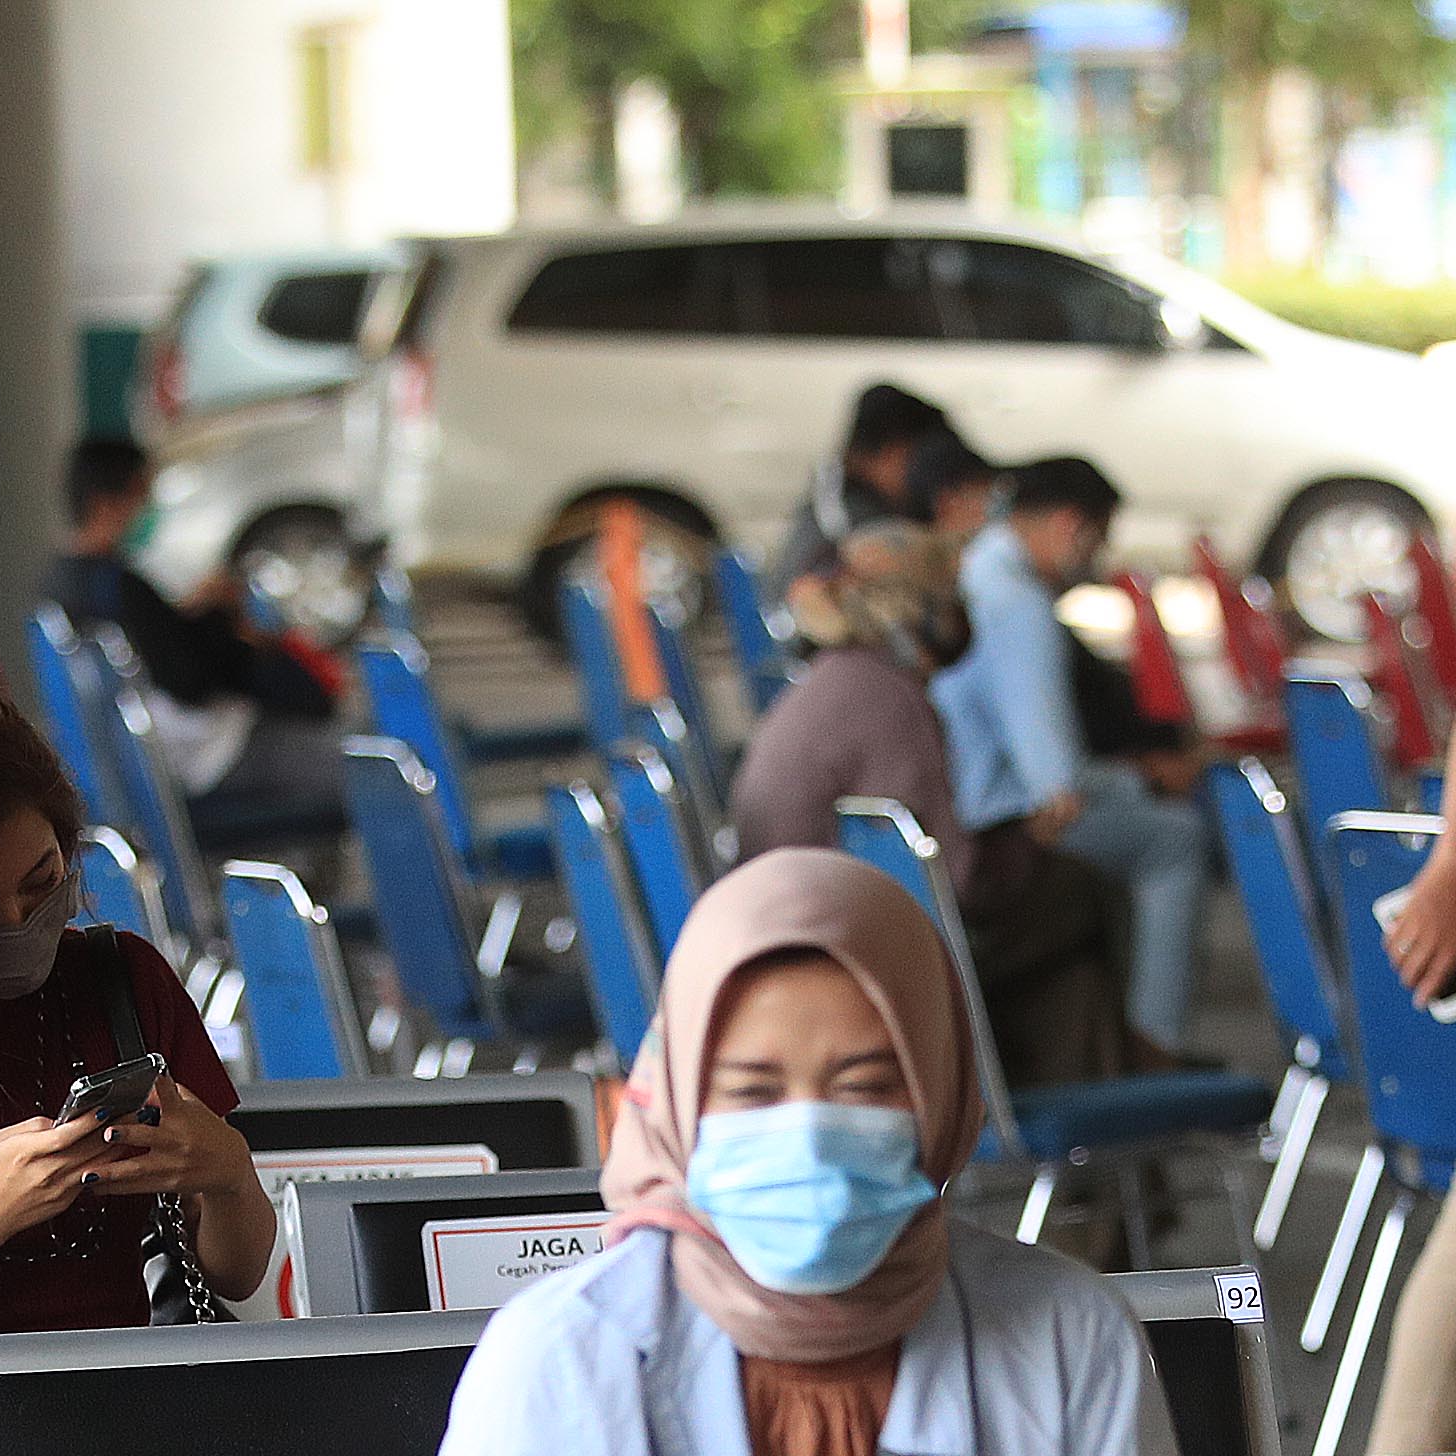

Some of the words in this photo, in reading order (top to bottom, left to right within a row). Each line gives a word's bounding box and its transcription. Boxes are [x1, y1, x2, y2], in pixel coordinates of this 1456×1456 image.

[517, 1237, 584, 1258] JAGA
[496, 1264, 537, 1279] Cegah
[1228, 1287, 1260, 1309] 92
